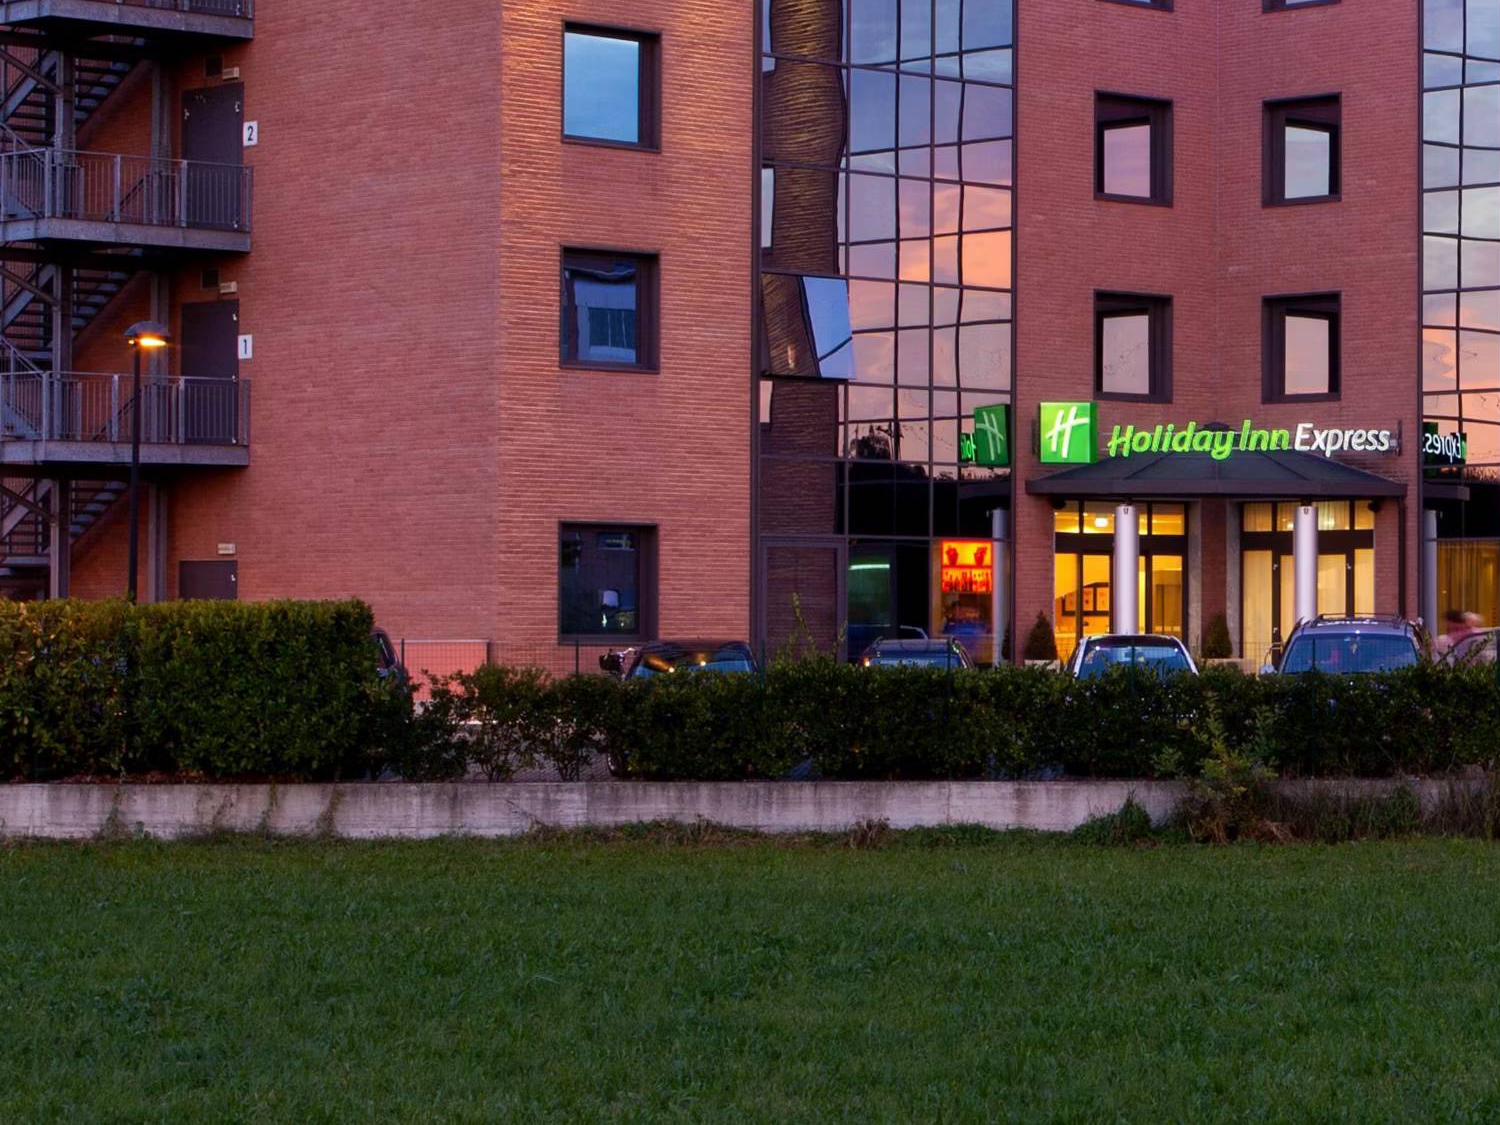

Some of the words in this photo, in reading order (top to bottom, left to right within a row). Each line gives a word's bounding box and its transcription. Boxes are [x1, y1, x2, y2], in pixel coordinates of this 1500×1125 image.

[247, 125, 254, 142] 2
[1107, 421, 1235, 460] Holiday
[1239, 419, 1290, 452] Inn
[1294, 422, 1390, 458] Express
